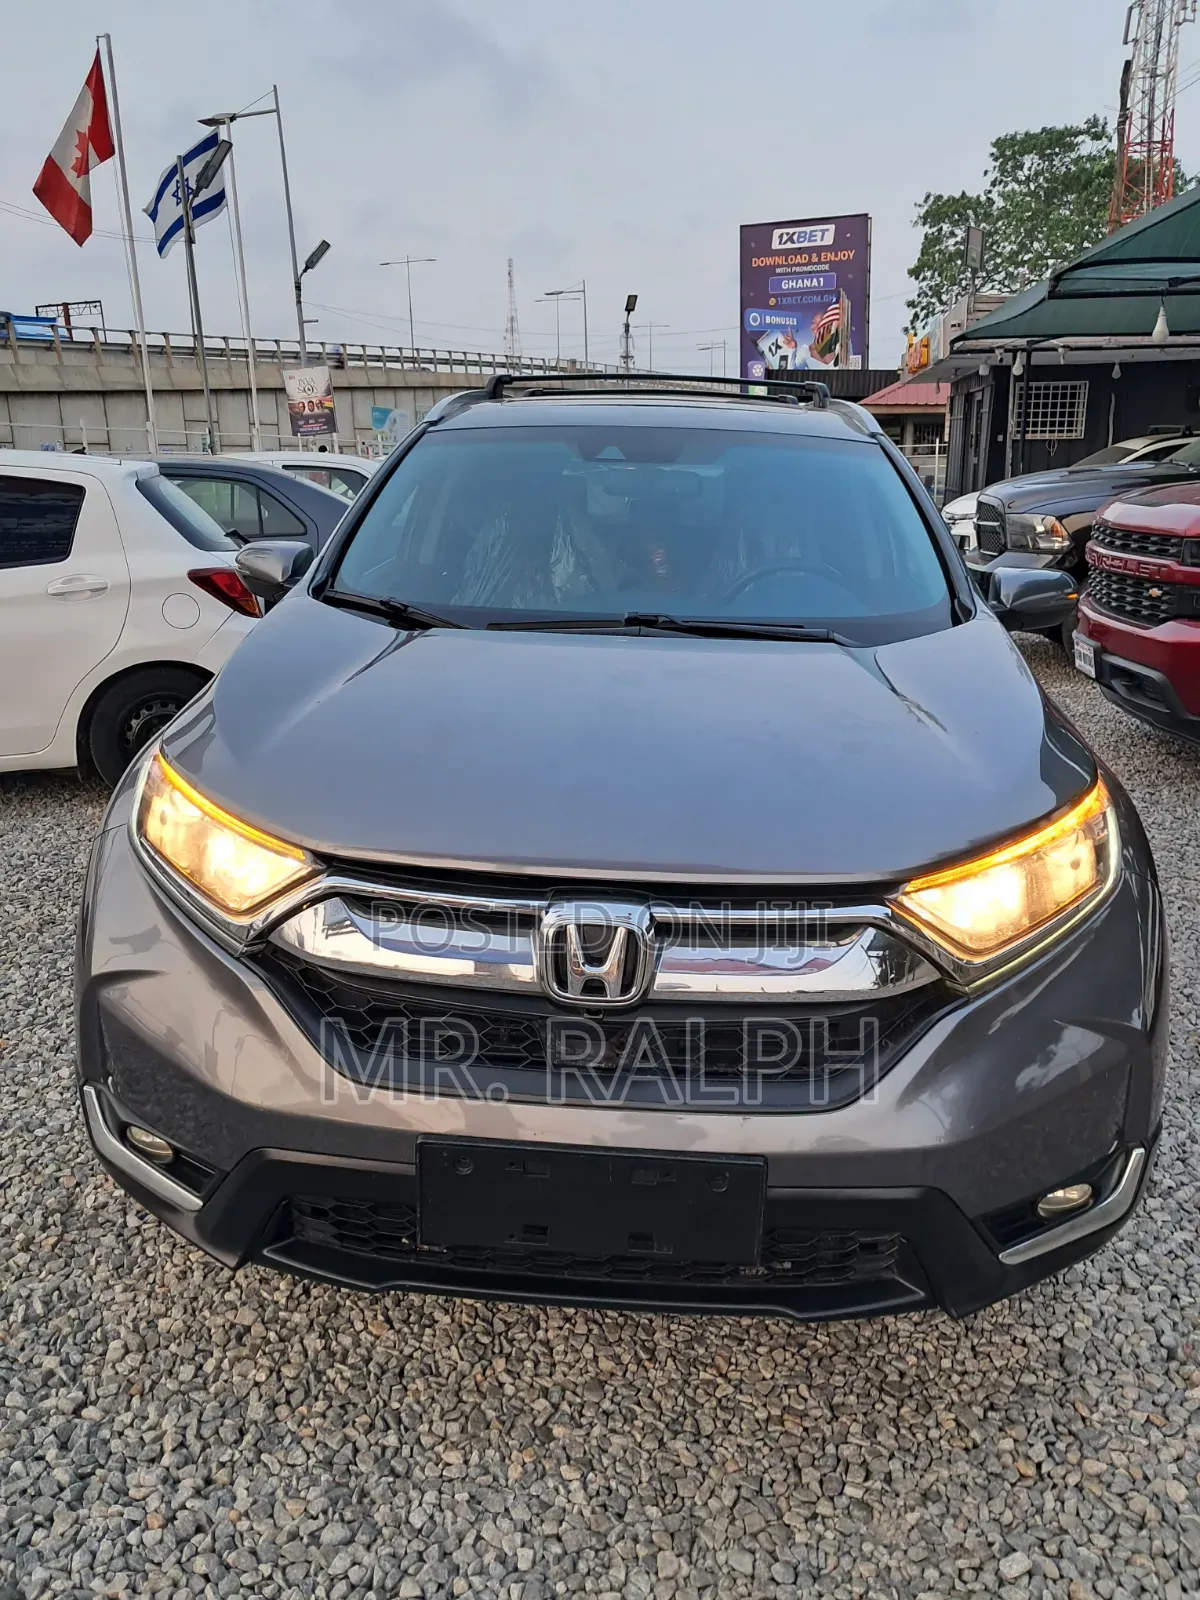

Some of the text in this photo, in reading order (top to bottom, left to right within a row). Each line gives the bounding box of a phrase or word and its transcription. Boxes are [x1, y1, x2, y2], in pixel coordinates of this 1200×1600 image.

[777, 228, 830, 245] 1XBET
[752, 250, 855, 267] DOWNLOAD & ENJOY
[792, 264, 830, 273] PROMOCODE
[781, 277, 824, 290] GHANA1
[765, 315, 797, 325] BONUSES
